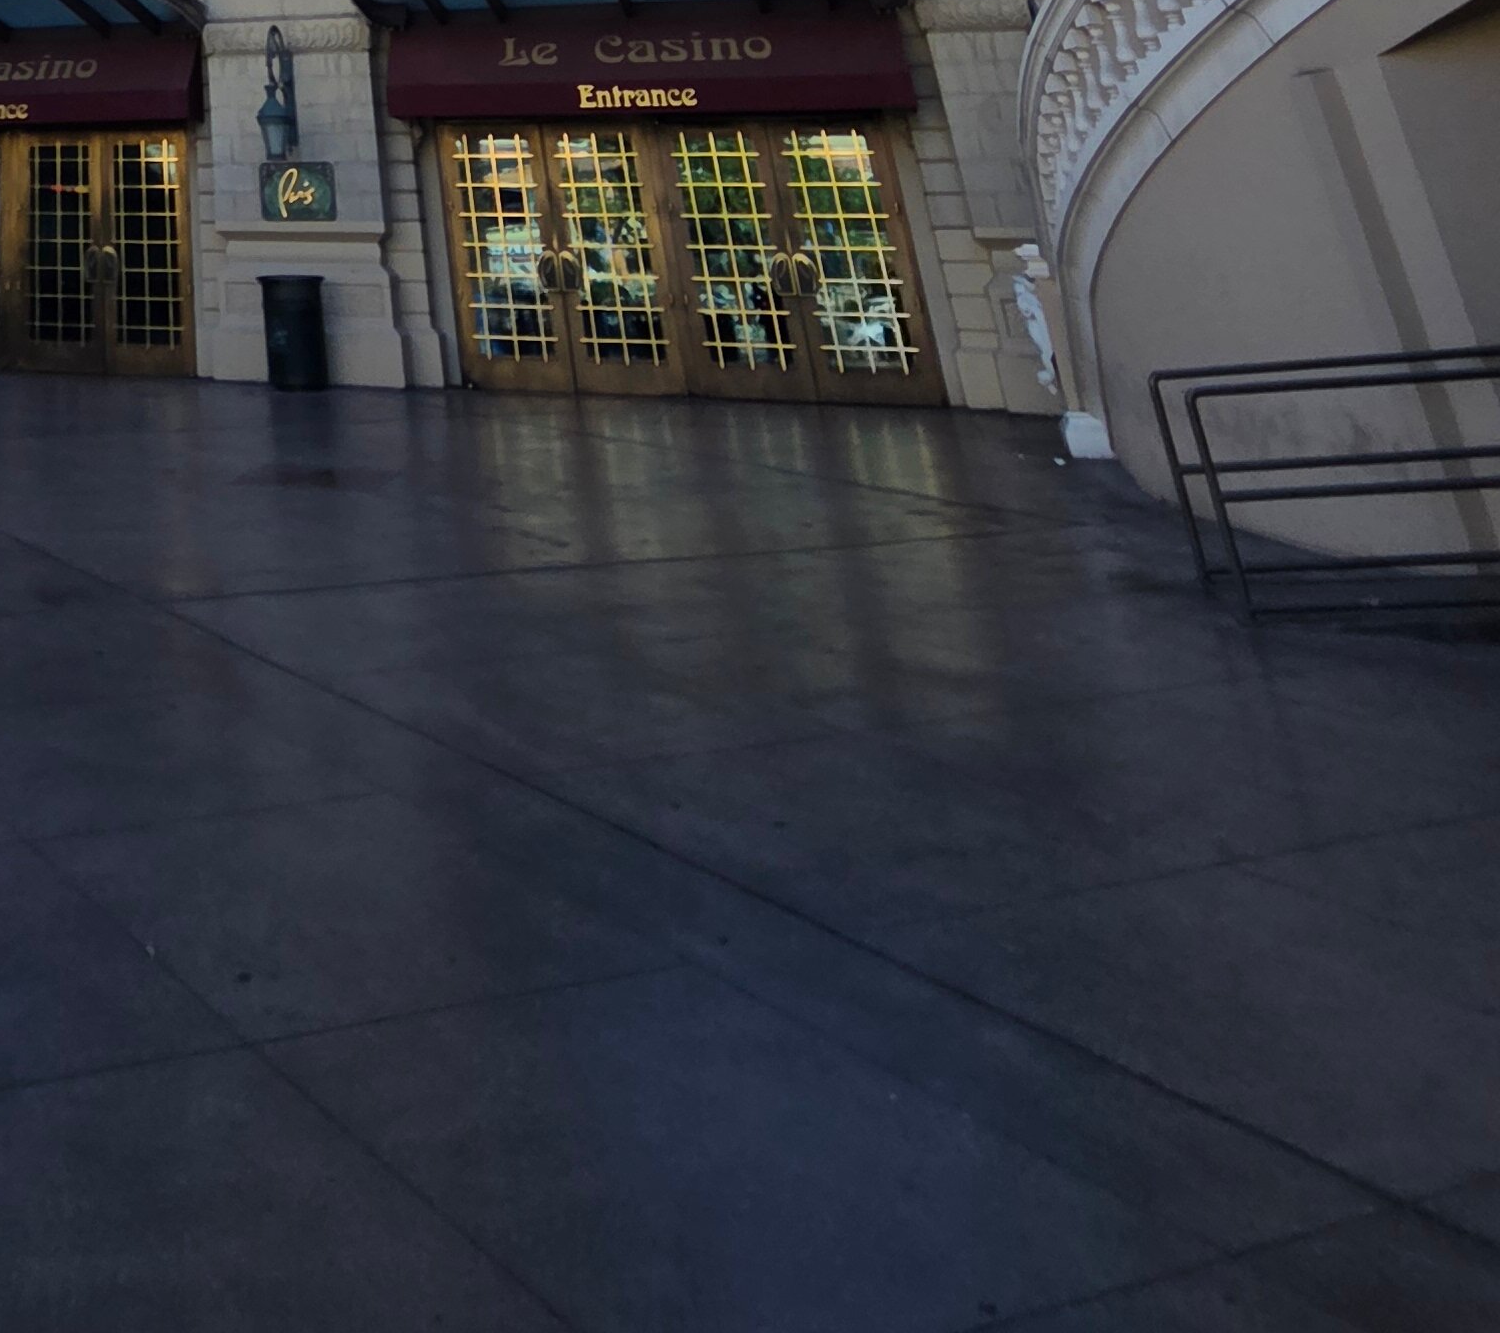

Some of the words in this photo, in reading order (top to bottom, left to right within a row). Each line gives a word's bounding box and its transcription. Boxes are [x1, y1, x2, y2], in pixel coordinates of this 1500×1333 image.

[499, 36, 559, 66] Le
[594, 31, 773, 64] Casino
[576, 83, 698, 109] Entrance
[277, 167, 316, 219] Paris
